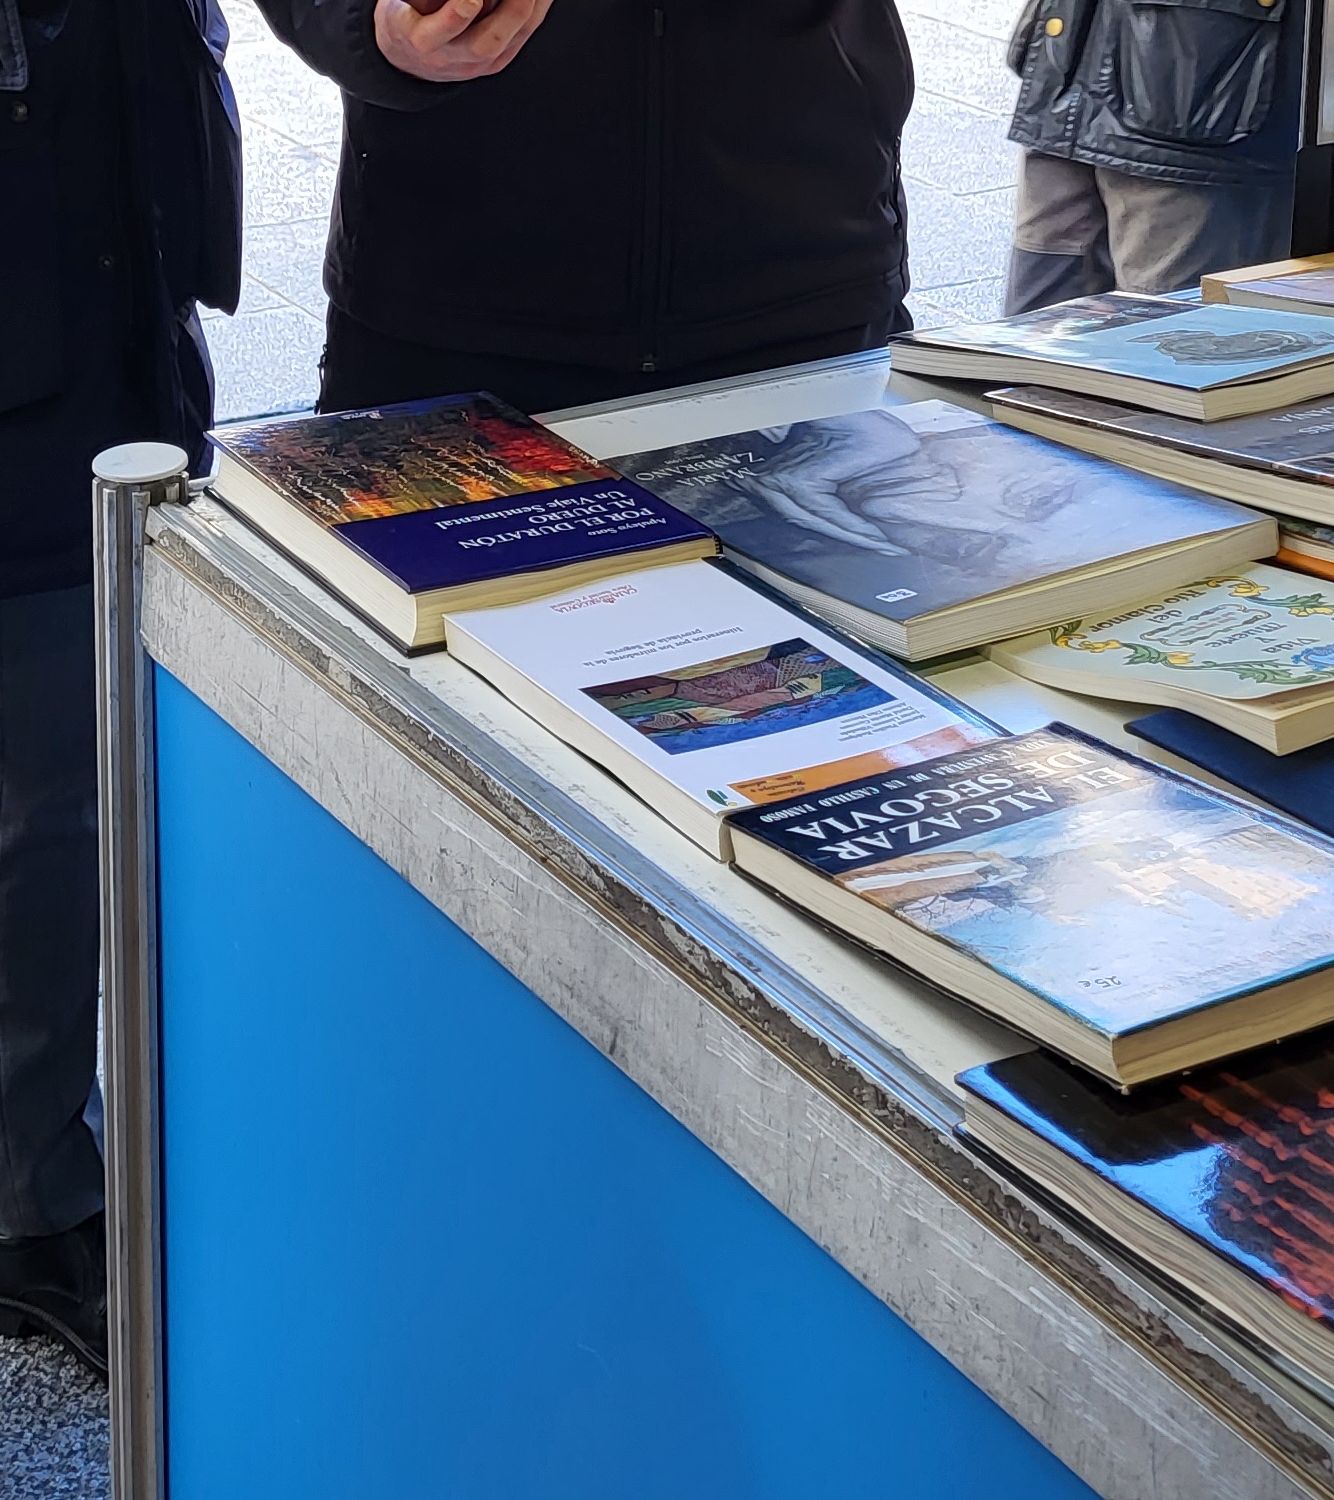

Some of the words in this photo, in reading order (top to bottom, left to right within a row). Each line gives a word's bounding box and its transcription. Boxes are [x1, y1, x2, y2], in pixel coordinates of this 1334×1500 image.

[635, 451, 766, 481] ZAMBRANO
[547, 495, 594, 511] Viaje
[595, 490, 627, 501] Un
[606, 497, 636, 510] AL
[434, 503, 546, 530] Sentimental
[528, 504, 609, 524] DUERO
[573, 516, 607, 527] EL
[607, 507, 656, 526] POR
[587, 525, 615, 537] Soto
[617, 516, 667, 535] Apuleyo
[457, 522, 576, 549] DURATÓN
[657, 628, 703, 645] provincia
[692, 626, 744, 642] Itinerarios
[604, 643, 644, 656] Segovia
[643, 640, 657, 649] de
[595, 657, 608, 666] de
[608, 647, 658, 663] miradores
[931, 750, 1005, 776] AVENTURA
[1016, 749, 1097, 780] DE
[882, 777, 907, 792] UN
[907, 770, 932, 784] DE
[1065, 767, 1134, 791] EL
[818, 784, 882, 809] CASTILLO
[759, 802, 817, 824] FAMOSO
[785, 772, 1015, 840] SEGOVIA
[817, 785, 1056, 862] ALCAZAR
